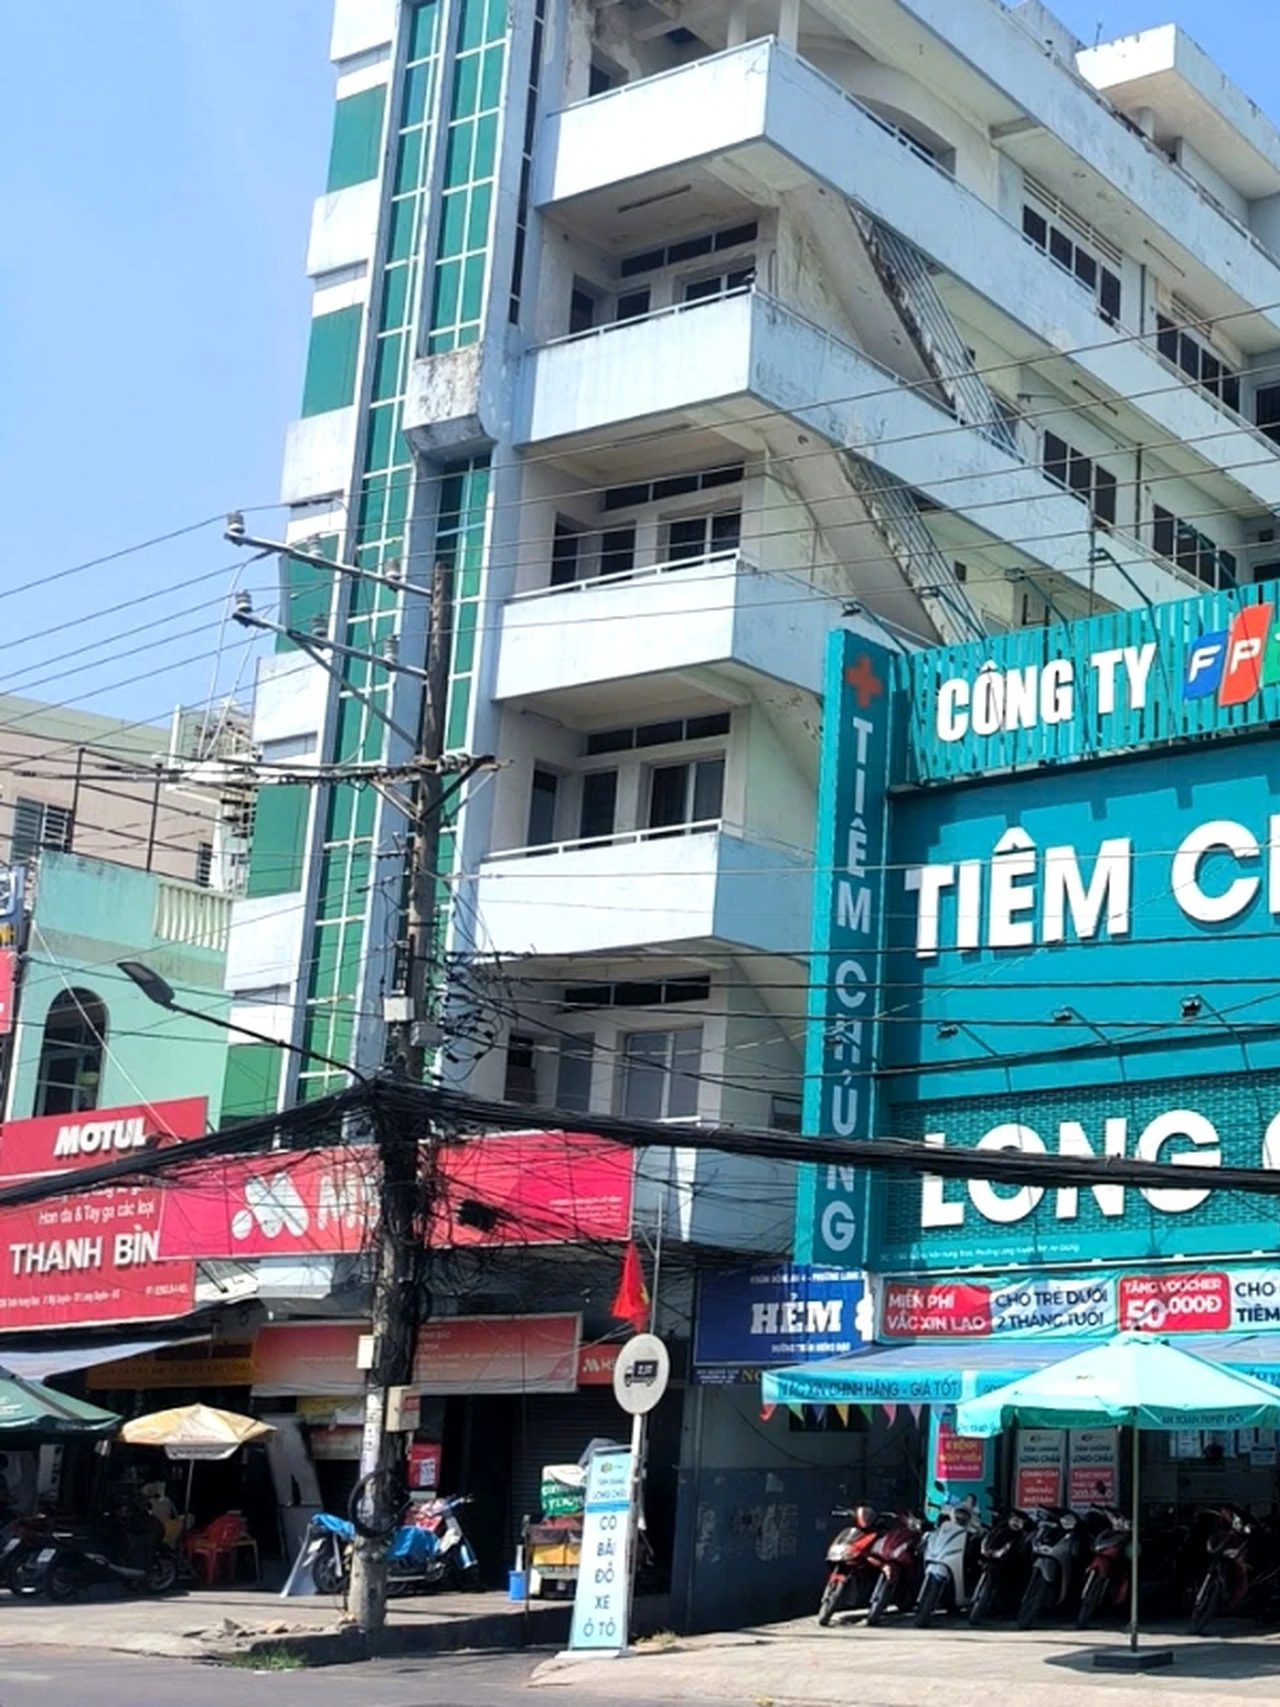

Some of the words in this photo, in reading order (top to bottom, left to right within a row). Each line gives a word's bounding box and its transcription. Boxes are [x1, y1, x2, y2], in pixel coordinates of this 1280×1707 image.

[937, 659, 1074, 743] CÔNG
[1091, 642, 1156, 715] TY
[836, 715, 873, 934] TIÊM
[906, 826, 1133, 960] TIÊM
[53, 1116, 147, 1156] MOTUL
[920, 1110, 1222, 1229] LONG
[60, 1210, 74, 1223] da
[75, 1207, 83, 1222] &
[84, 1204, 101, 1223] Tay
[102, 1207, 116, 1222] ga
[117, 1202, 135, 1217] các
[137, 1199, 155, 1221] loại
[9, 1236, 103, 1275] THANH
[113, 1223, 161, 1265] BÌN
[995, 1290, 1032, 1308] CHO
[1034, 1285, 1064, 1306] TRẺ
[1066, 1286, 1109, 1305] DƯỚI
[1160, 1277, 1222, 1294] VOUCHER
[1235, 1280, 1276, 1298] CHO
[888, 1287, 924, 1309] MIỄN
[926, 1289, 955, 1309] PHÍ
[750, 1291, 844, 1335] HẺM
[887, 1312, 921, 1334] VẮC
[920, 1316, 948, 1332] XIN
[951, 1314, 988, 1331] LAO
[997, 1315, 1009, 1333] 2
[1009, 1309, 1064, 1329] THÁNG
[1066, 1308, 1105, 1328] TUỔI
[1236, 1303, 1280, 1323] TIÊM
[808, 1381, 827, 1397] XIN
[829, 1379, 863, 1397] CHÍNH
[910, 1379, 931, 1397] GIÁ
[934, 1378, 959, 1397] TỐT
[594, 1595, 611, 1610] XE
[582, 1617, 595, 1638] Ô
[598, 1617, 616, 1637] TÔ
